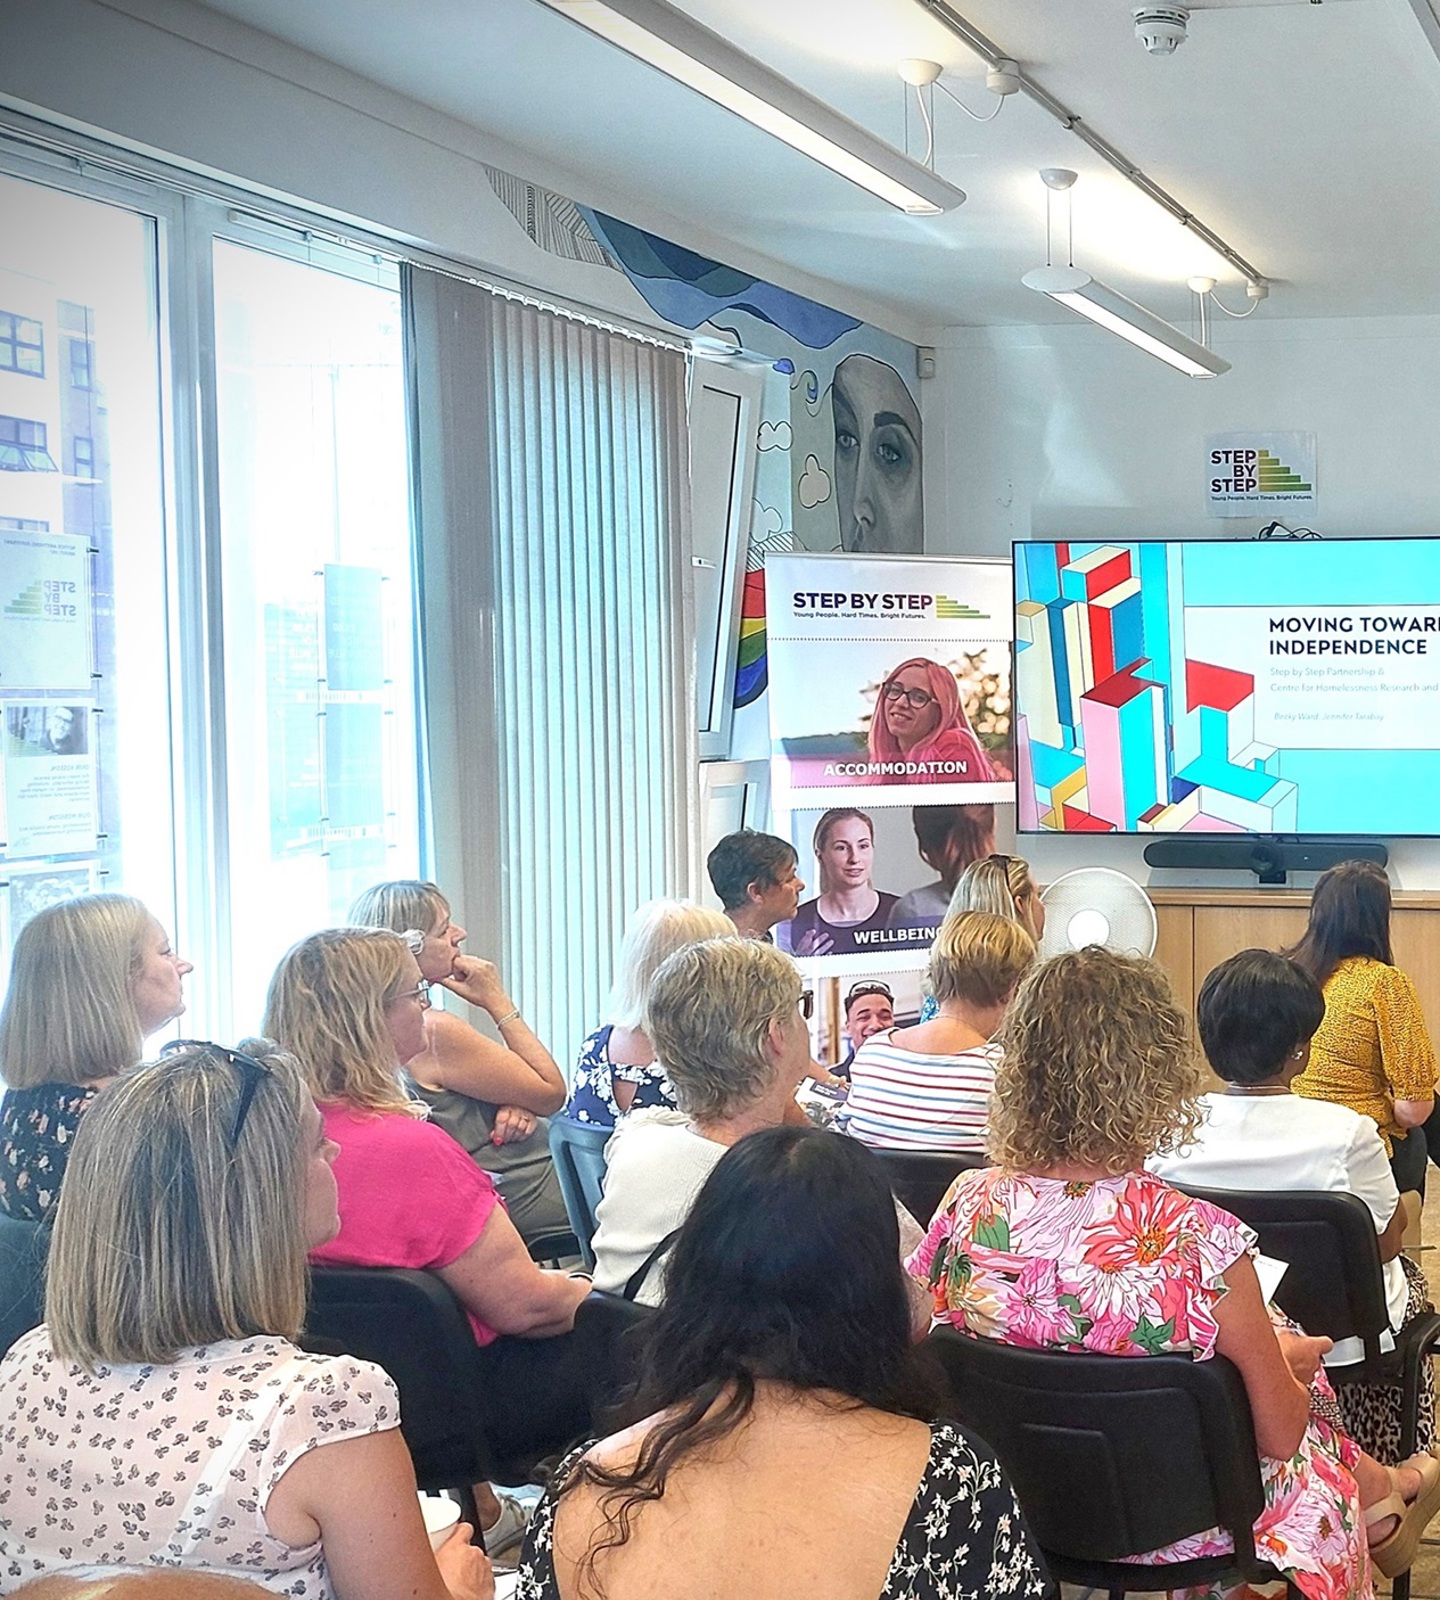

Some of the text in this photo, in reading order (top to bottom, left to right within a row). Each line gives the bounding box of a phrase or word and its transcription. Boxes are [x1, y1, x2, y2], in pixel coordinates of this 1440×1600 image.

[1210, 450, 1257, 464] STEP
[1233, 465, 1257, 477] BY
[1210, 479, 1257, 493] STEP
[793, 592, 933, 610] STEP BY STEP
[793, 611, 814, 619] Young
[881, 612, 900, 620] Bright
[1269, 617, 1353, 633] MOVING
[1269, 639, 1427, 655] INDEPENDENCE
[1270, 667, 1385, 677] Step by Step Partnership &
[1270, 683, 1300, 692] Centre
[1301, 683, 1314, 692] for
[1316, 683, 1378, 692] Homelessness
[1380, 683, 1420, 692] Research
[1421, 683, 1439, 692] and
[1273, 712, 1296, 722] Becky
[824, 761, 968, 777] ACCOMMODATION
